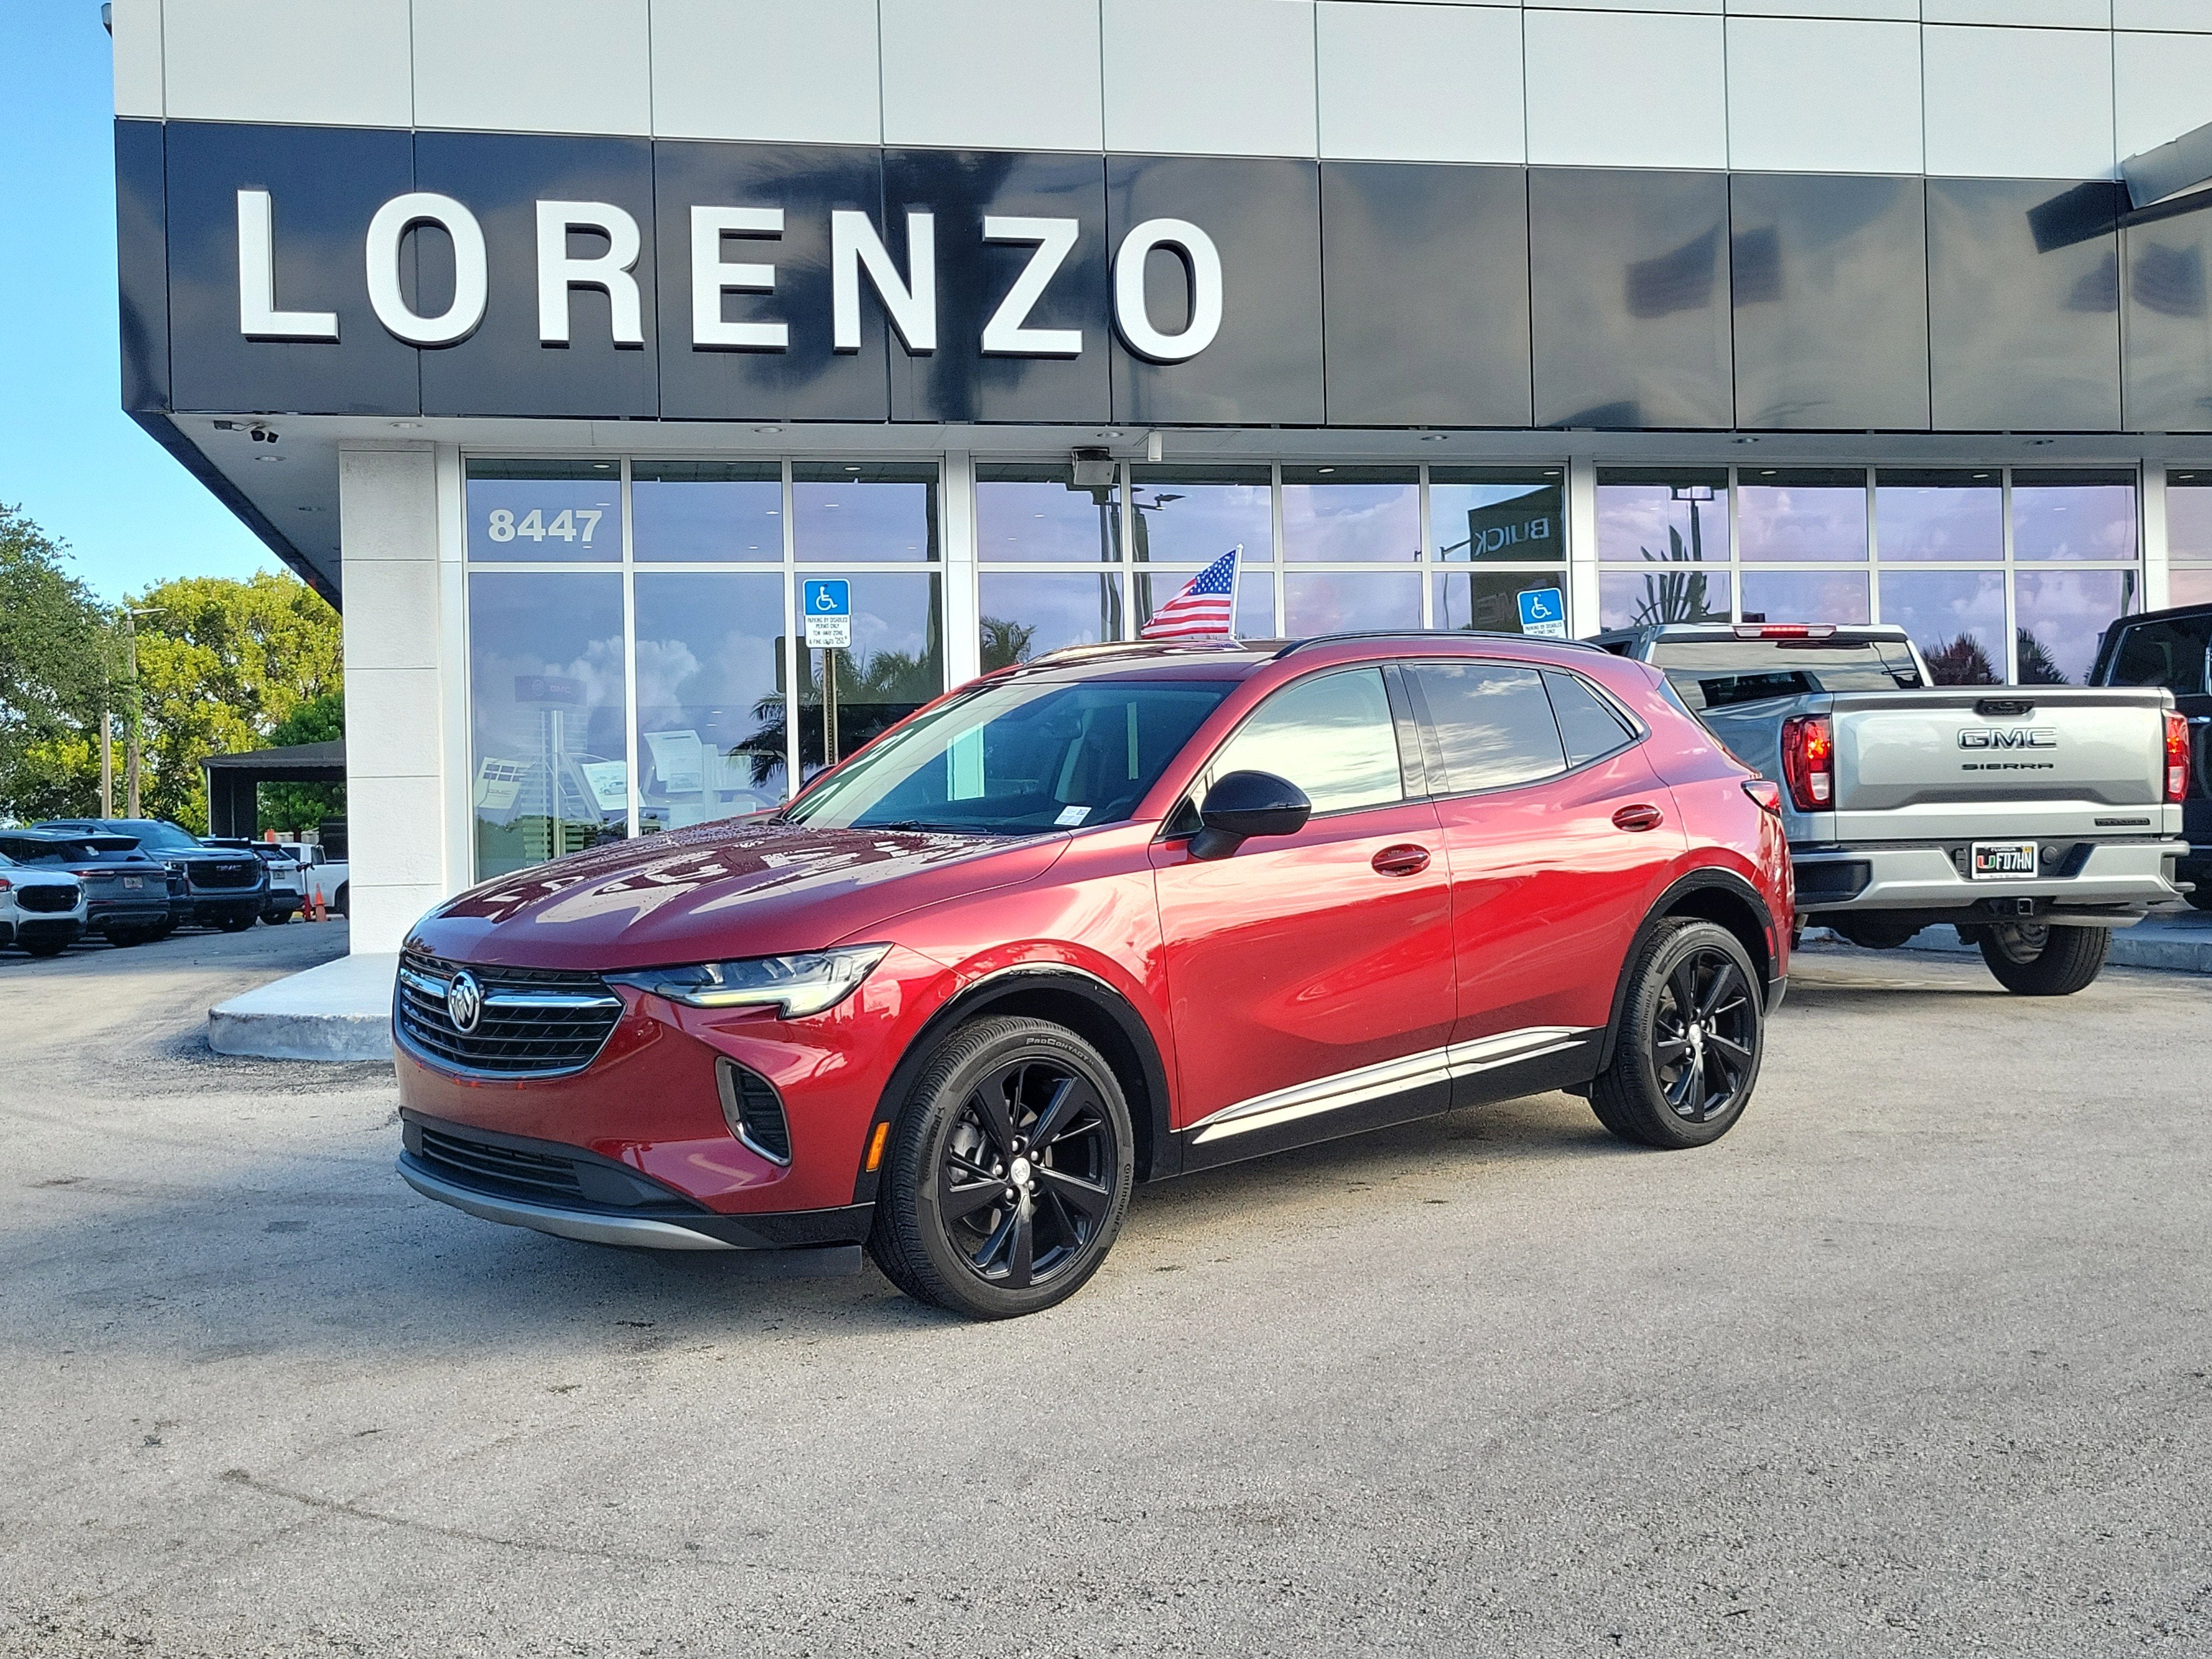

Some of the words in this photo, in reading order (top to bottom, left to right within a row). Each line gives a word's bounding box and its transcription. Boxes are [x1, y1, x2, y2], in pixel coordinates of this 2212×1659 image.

[237, 189, 1223, 362] LORENZO
[488, 509, 602, 542] 8447
[1957, 727, 2057, 751] GMC
[1961, 763, 2054, 771] SIERRA
[1113, 1163, 1132, 1226] Continental
